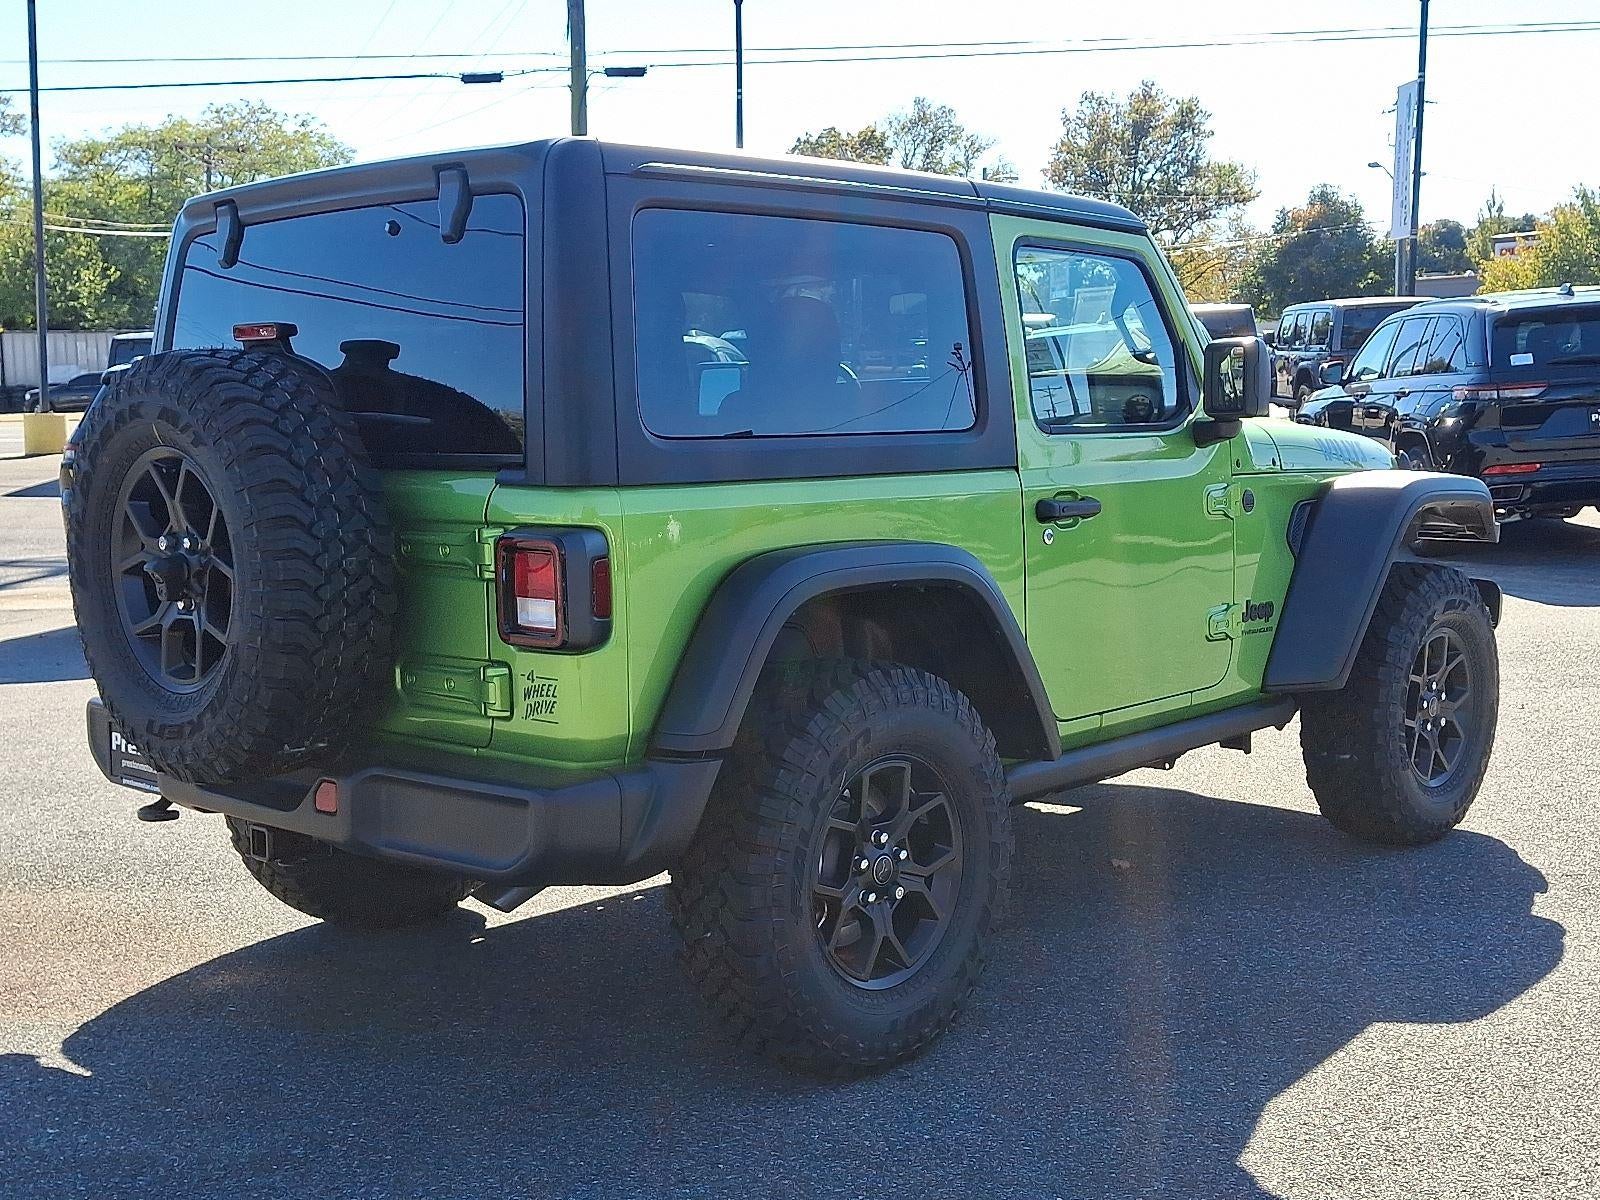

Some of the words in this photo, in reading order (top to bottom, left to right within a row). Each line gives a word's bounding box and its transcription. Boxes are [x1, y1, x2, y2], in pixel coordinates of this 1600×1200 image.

[1242, 599, 1274, 623] Jeep
[526, 669, 535, 683] 4
[523, 684, 557, 701] WHEEL
[525, 700, 557, 720] DRIVE
[111, 731, 142, 756] Pre
